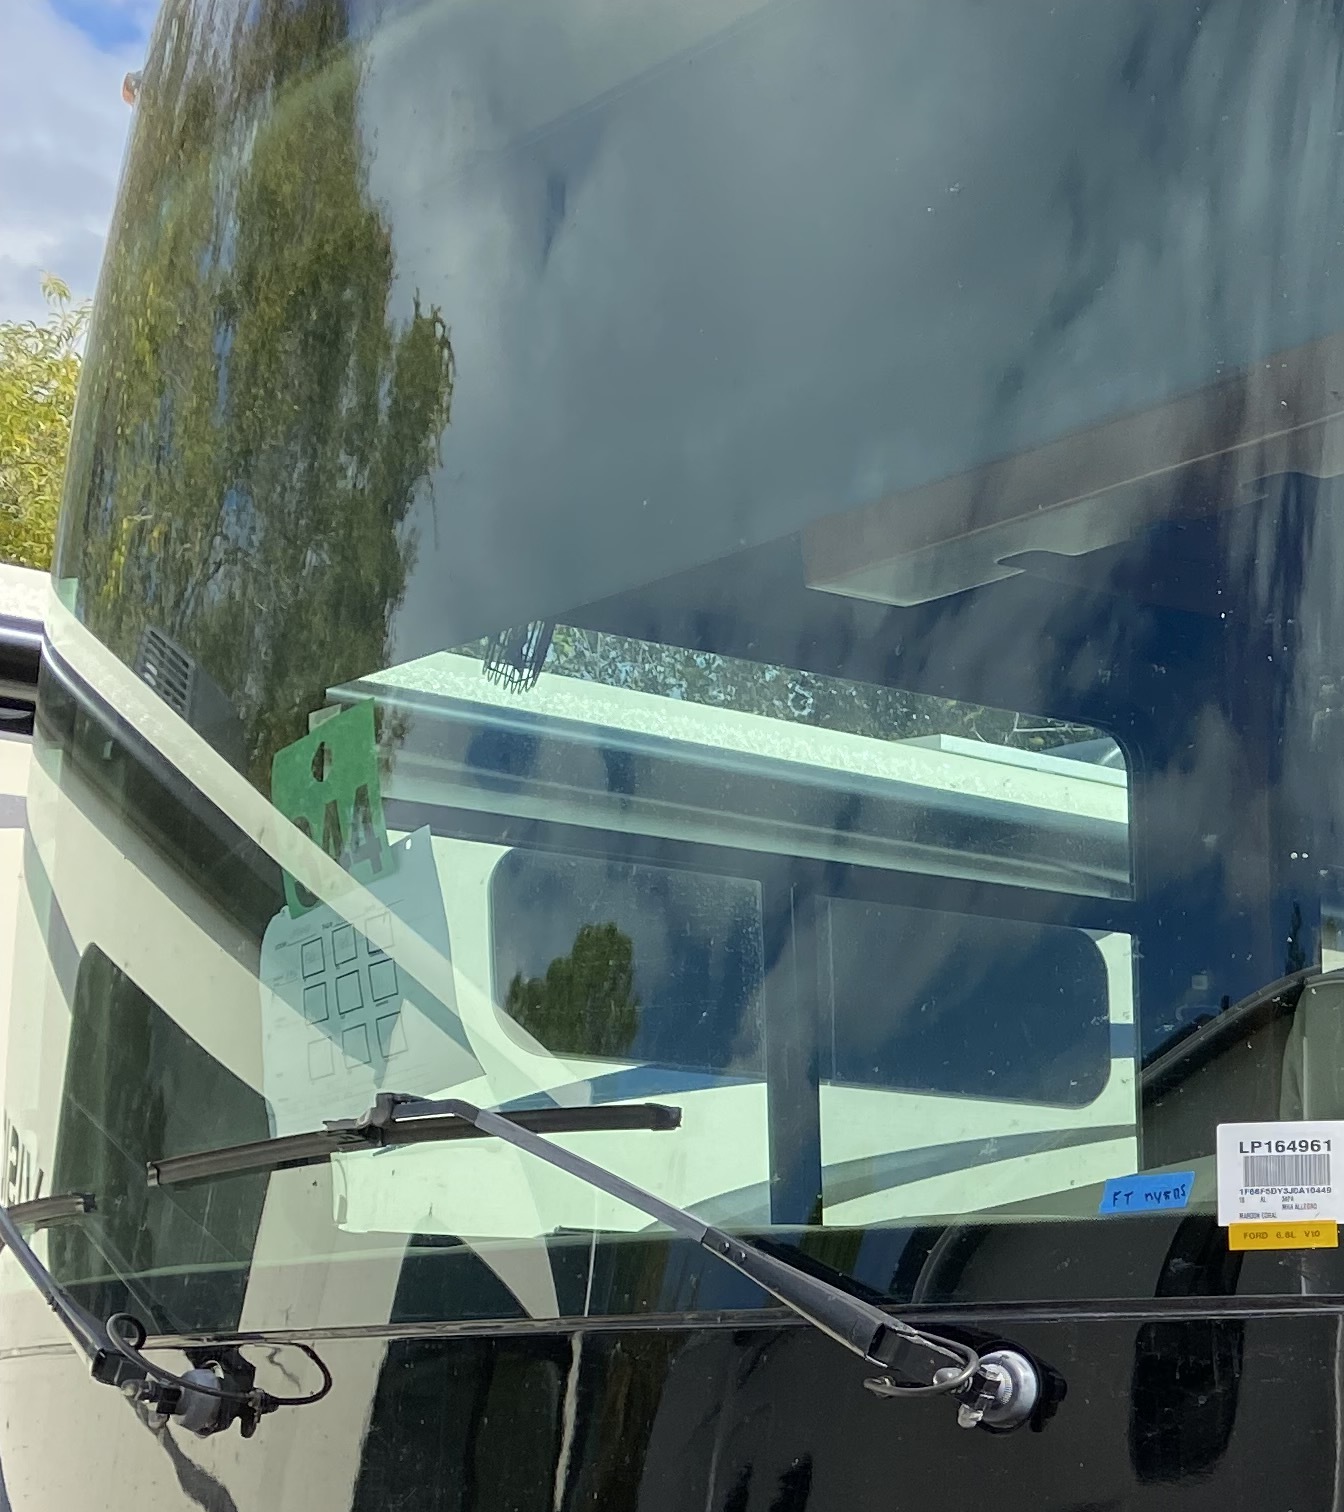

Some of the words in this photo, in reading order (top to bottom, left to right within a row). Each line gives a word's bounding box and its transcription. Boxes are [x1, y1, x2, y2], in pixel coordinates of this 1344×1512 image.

[1239, 1139, 1331, 1153] LP164961
[1112, 1190, 1134, 1207] FT
[1243, 1231, 1269, 1240] FORD
[1275, 1231, 1297, 1239] 6.8L
[1304, 1230, 1321, 1238] V10
